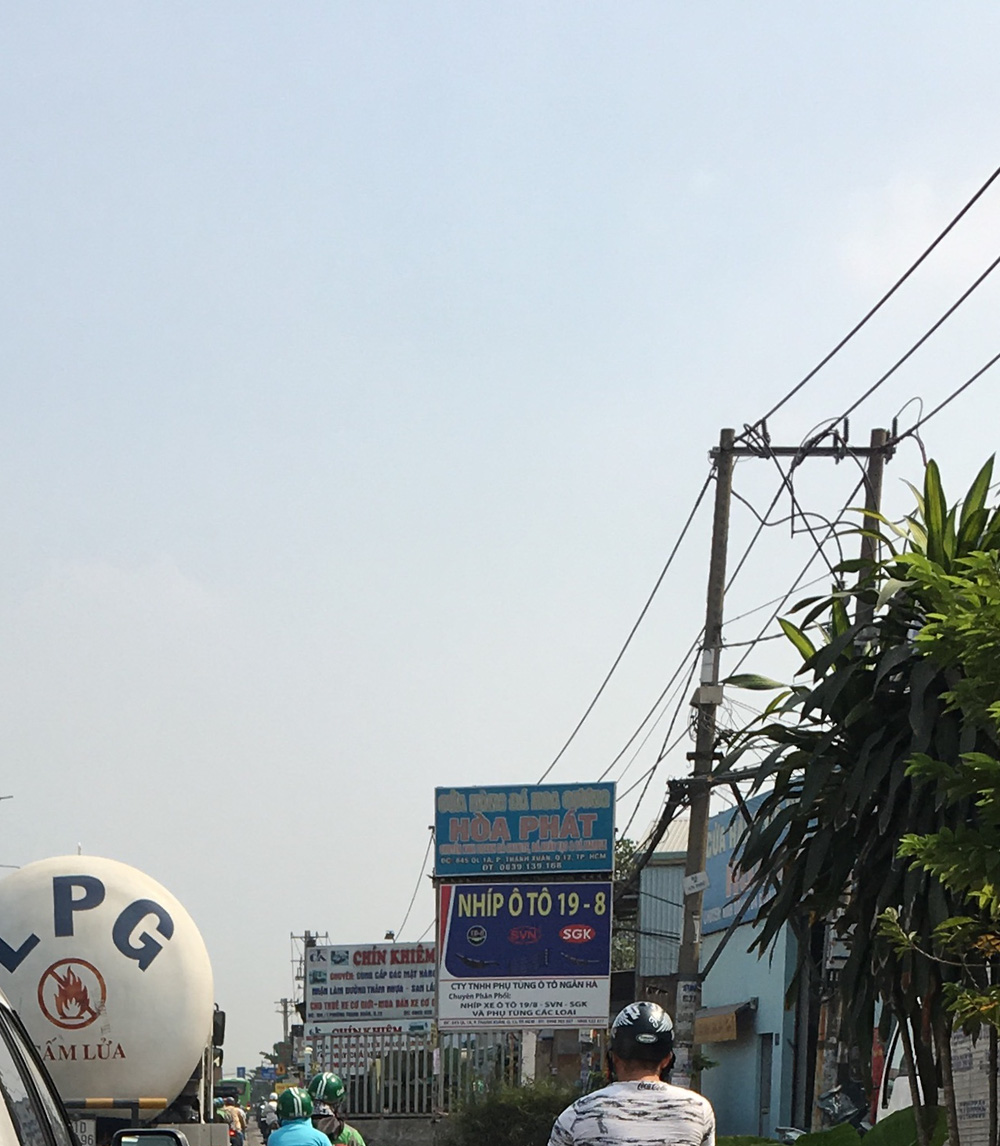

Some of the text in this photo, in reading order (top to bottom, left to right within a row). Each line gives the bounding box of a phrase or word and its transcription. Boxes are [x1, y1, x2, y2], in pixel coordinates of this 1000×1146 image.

[449, 808, 598, 843] HÒA PHÁT
[457, 888, 505, 918] NHÍP
[508, 887, 524, 918] Ô
[526, 887, 553, 917] TÔ
[557, 891, 580, 917] 19
[562, 928, 592, 940] SGK
[352, 944, 435, 966] CHÍN KHIÊM
[450, 982, 467, 991] CTY
[468, 982, 491, 990] TNHH
[493, 982, 511, 991] PHỤ
[513, 980, 537, 990] TÙNG
[538, 980, 545, 989] Ô
[546, 980, 558, 989] TÔ
[448, 993, 474, 1001] Chuyên
[460, 1001, 482, 1009] NHÍP
[496, 1001, 504, 1009] Ô
[505, 1001, 517, 1009] TÔ
[519, 1001, 538, 1009] 19/8
[472, 1009, 485, 1017] VÀ
[486, 1010, 506, 1018] PHỤ
[535, 1008, 553, 1016] CÁC
[35, 1037, 127, 1061] ẤM LỬA
[74, 1121, 87, 1134] 1D
[80, 1134, 94, 1146] 96
